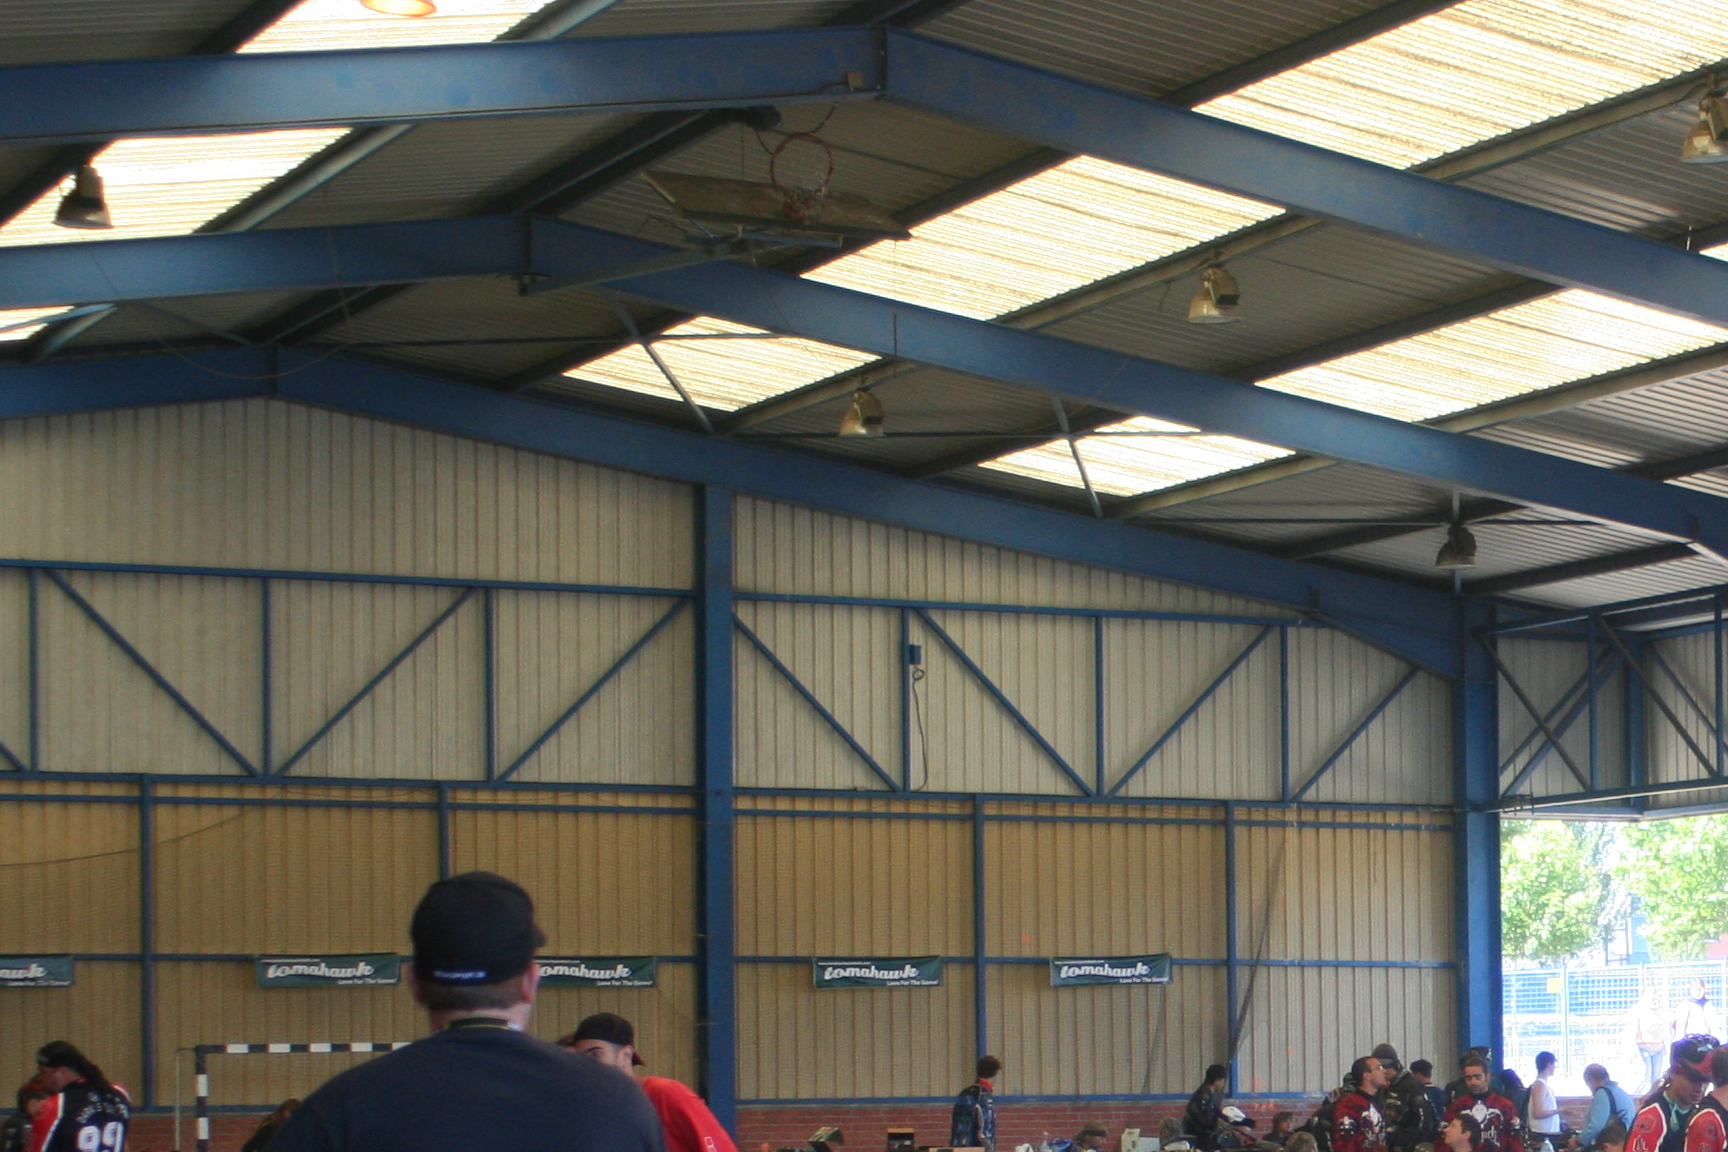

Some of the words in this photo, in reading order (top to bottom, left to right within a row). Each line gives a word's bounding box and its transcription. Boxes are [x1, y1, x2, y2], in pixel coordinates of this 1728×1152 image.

[267, 961, 374, 979] tomahawk
[539, 963, 631, 979] omahawk
[824, 964, 919, 980] tomahawk
[1060, 962, 1150, 978] tomahawk
